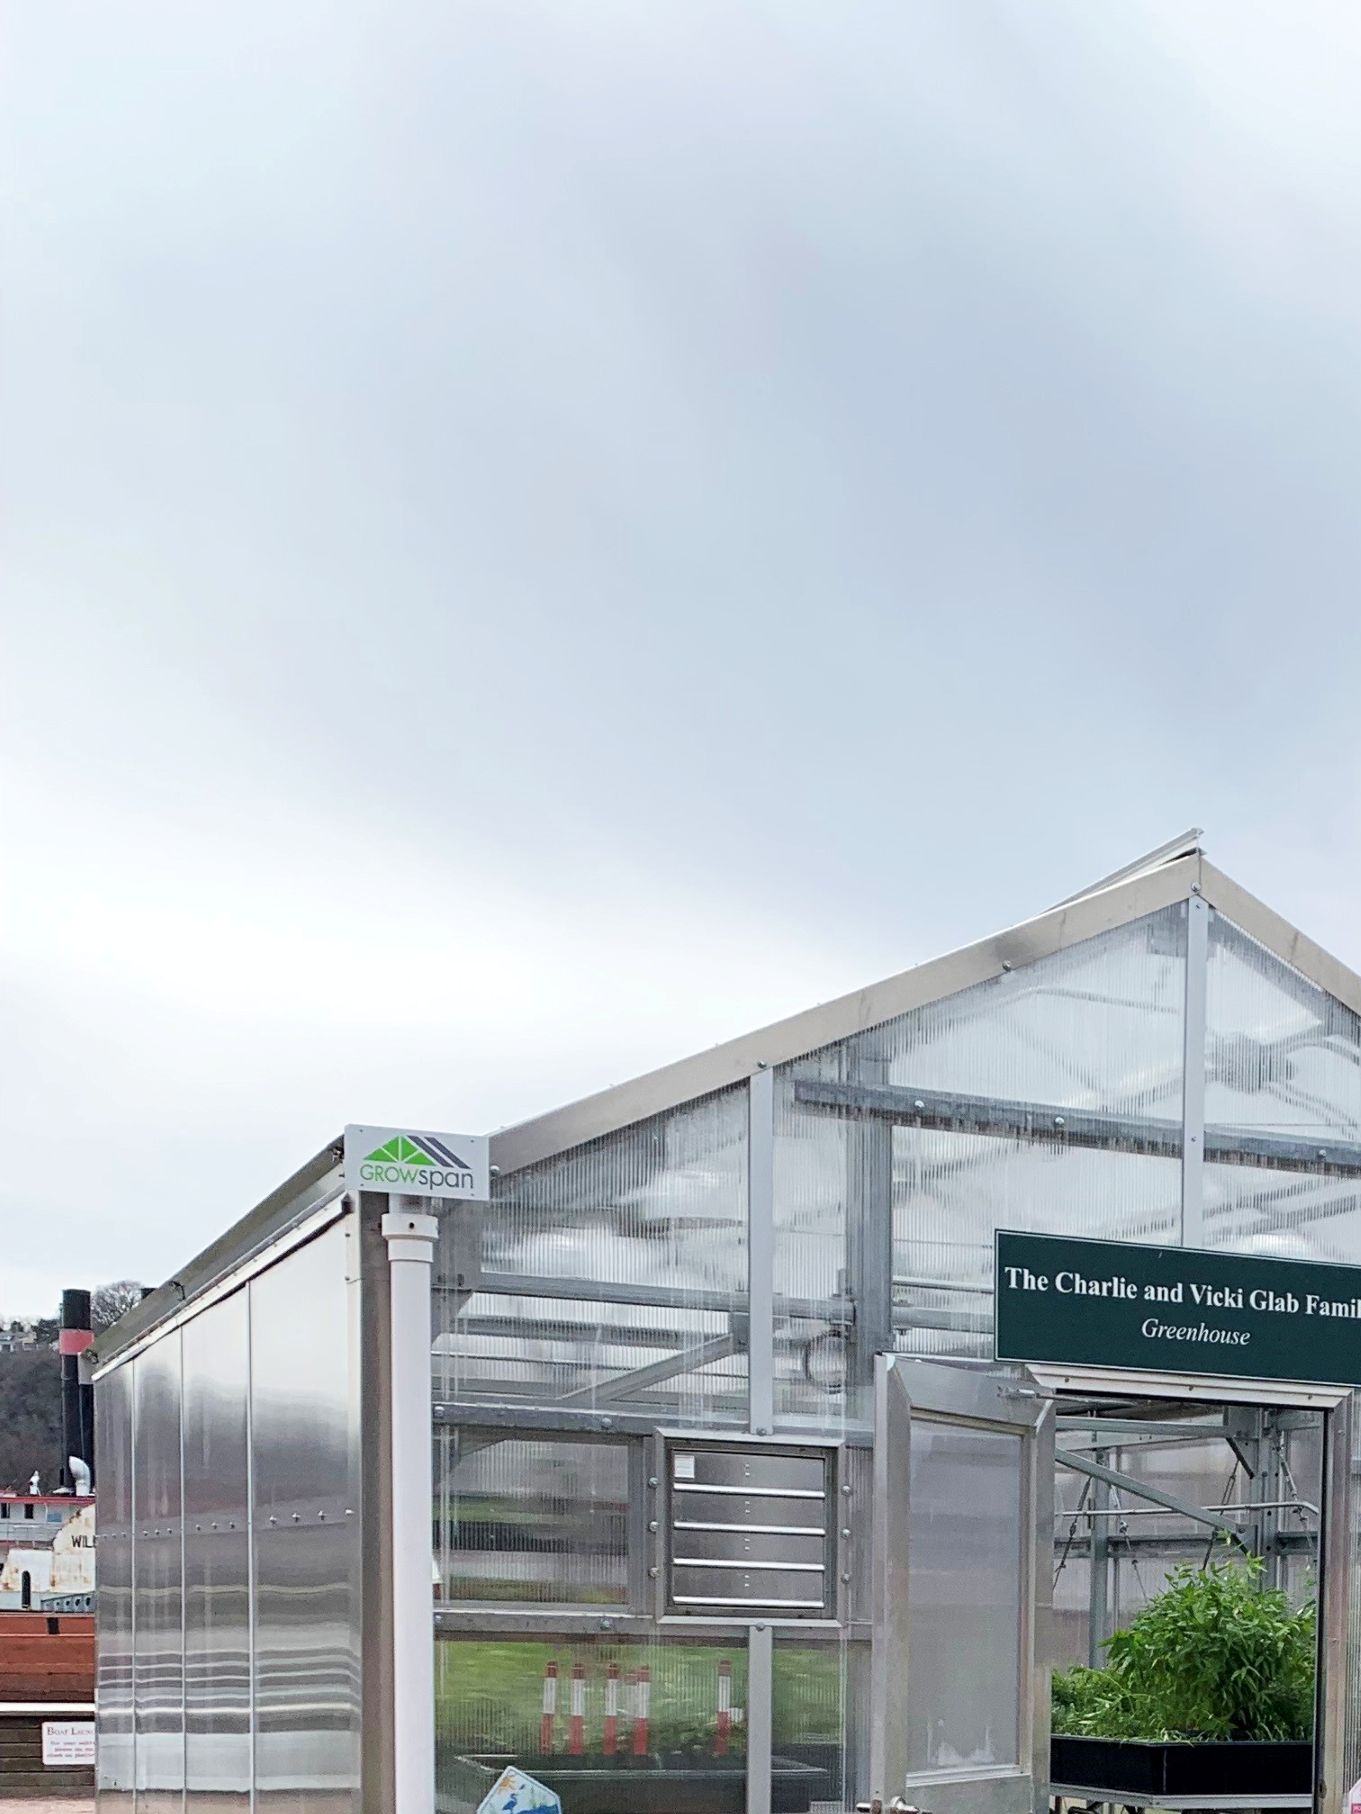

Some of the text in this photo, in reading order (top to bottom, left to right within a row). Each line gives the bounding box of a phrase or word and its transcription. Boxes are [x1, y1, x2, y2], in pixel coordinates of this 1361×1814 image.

[360, 1164, 474, 1190] GROWspan
[1004, 1266, 1049, 1291] The
[1055, 1271, 1138, 1299] Charlie
[1144, 1282, 1183, 1303] and
[1190, 1283, 1244, 1309] Vicki
[1250, 1289, 1299, 1313] Glab
[1142, 1318, 1251, 1345] Greenhouse
